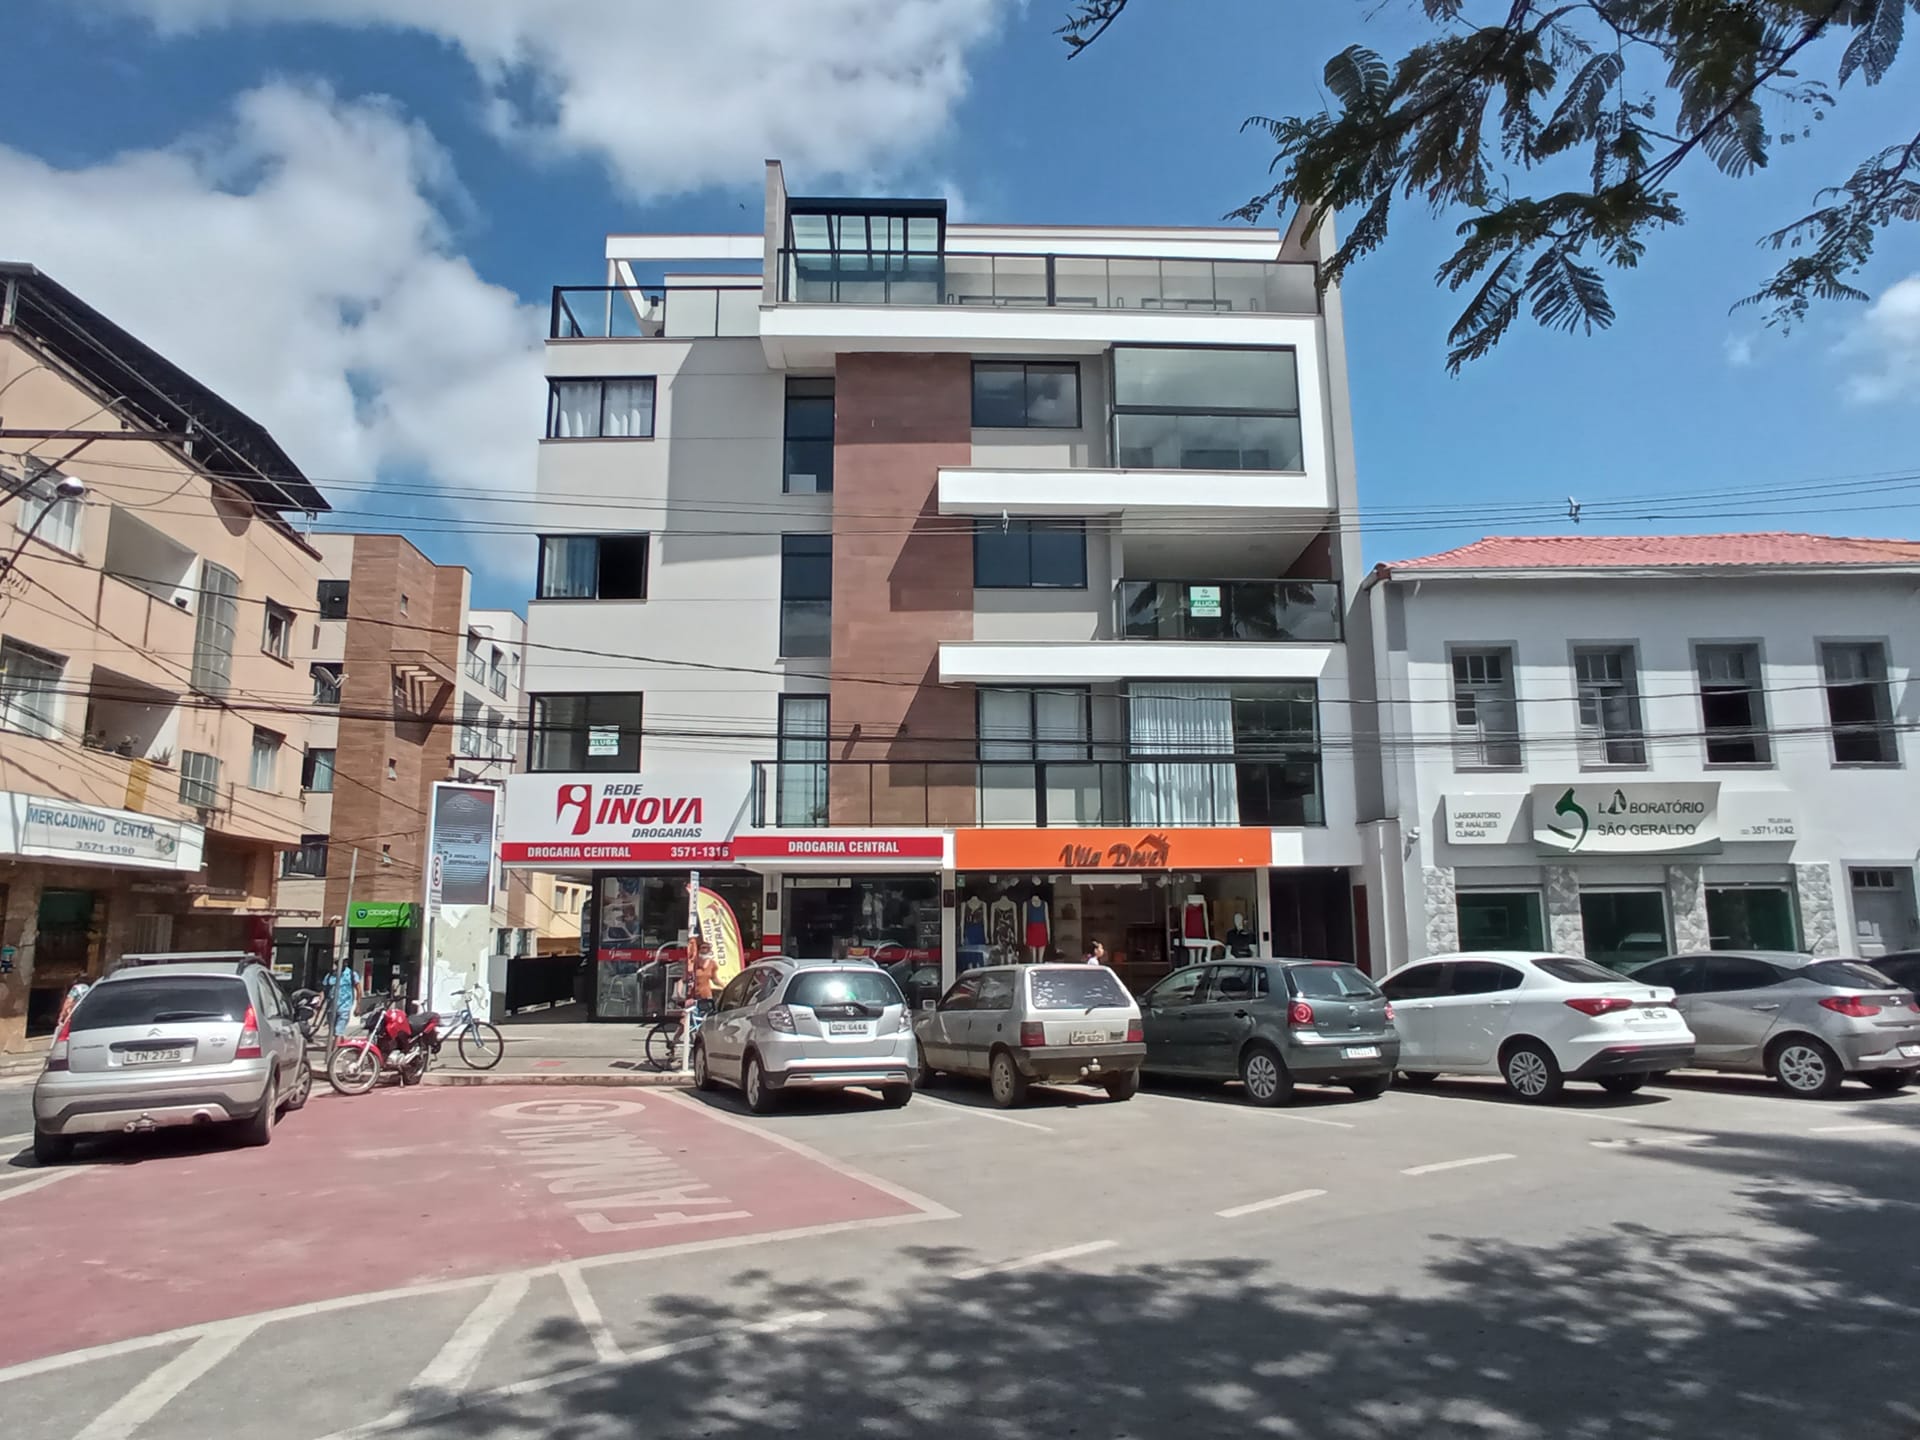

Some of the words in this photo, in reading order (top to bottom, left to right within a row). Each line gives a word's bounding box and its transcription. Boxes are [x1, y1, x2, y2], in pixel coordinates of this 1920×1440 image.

[603, 784, 643, 796] REDE
[1598, 788, 1705, 815] LABORATÓRIO
[595, 797, 703, 825] INOVA
[29, 808, 106, 832] MERCADINHO
[114, 822, 155, 840] CENTER
[1597, 822, 1626, 836] SÃO
[1630, 823, 1697, 836] GERALDO
[631, 828, 702, 838] DROGARIAS
[527, 846, 581, 858] DROGARIA
[583, 846, 631, 858] CENTRAL
[670, 846, 729, 858] 3571-1316
[788, 841, 846, 853] DROGARIA
[849, 841, 900, 853] CENTRAL
[714, 921, 726, 967] CENTRAL
